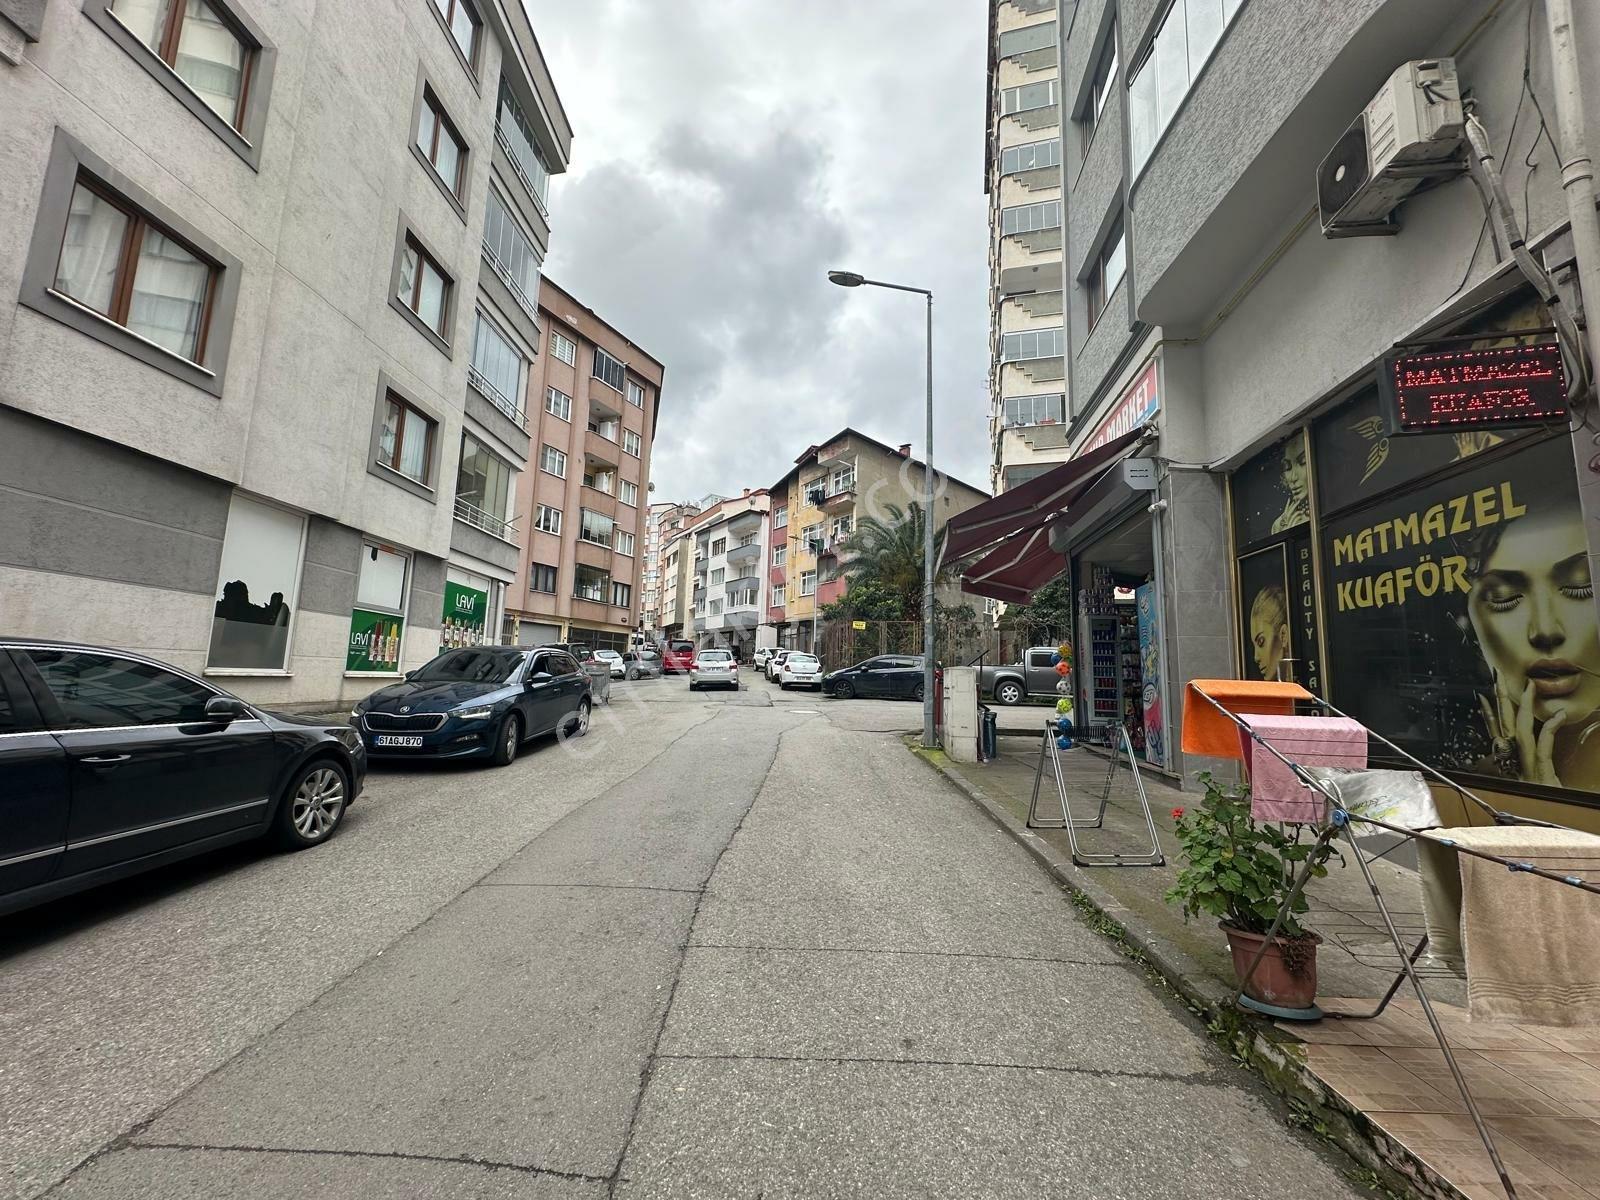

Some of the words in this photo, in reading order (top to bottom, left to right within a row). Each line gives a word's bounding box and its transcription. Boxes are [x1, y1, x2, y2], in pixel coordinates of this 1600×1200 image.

[1106, 377, 1149, 443] MARKET
[1333, 481, 1527, 567] MATMAZEL
[1300, 549, 1314, 641] BEAUTY
[1336, 554, 1473, 612] KUAFÖR
